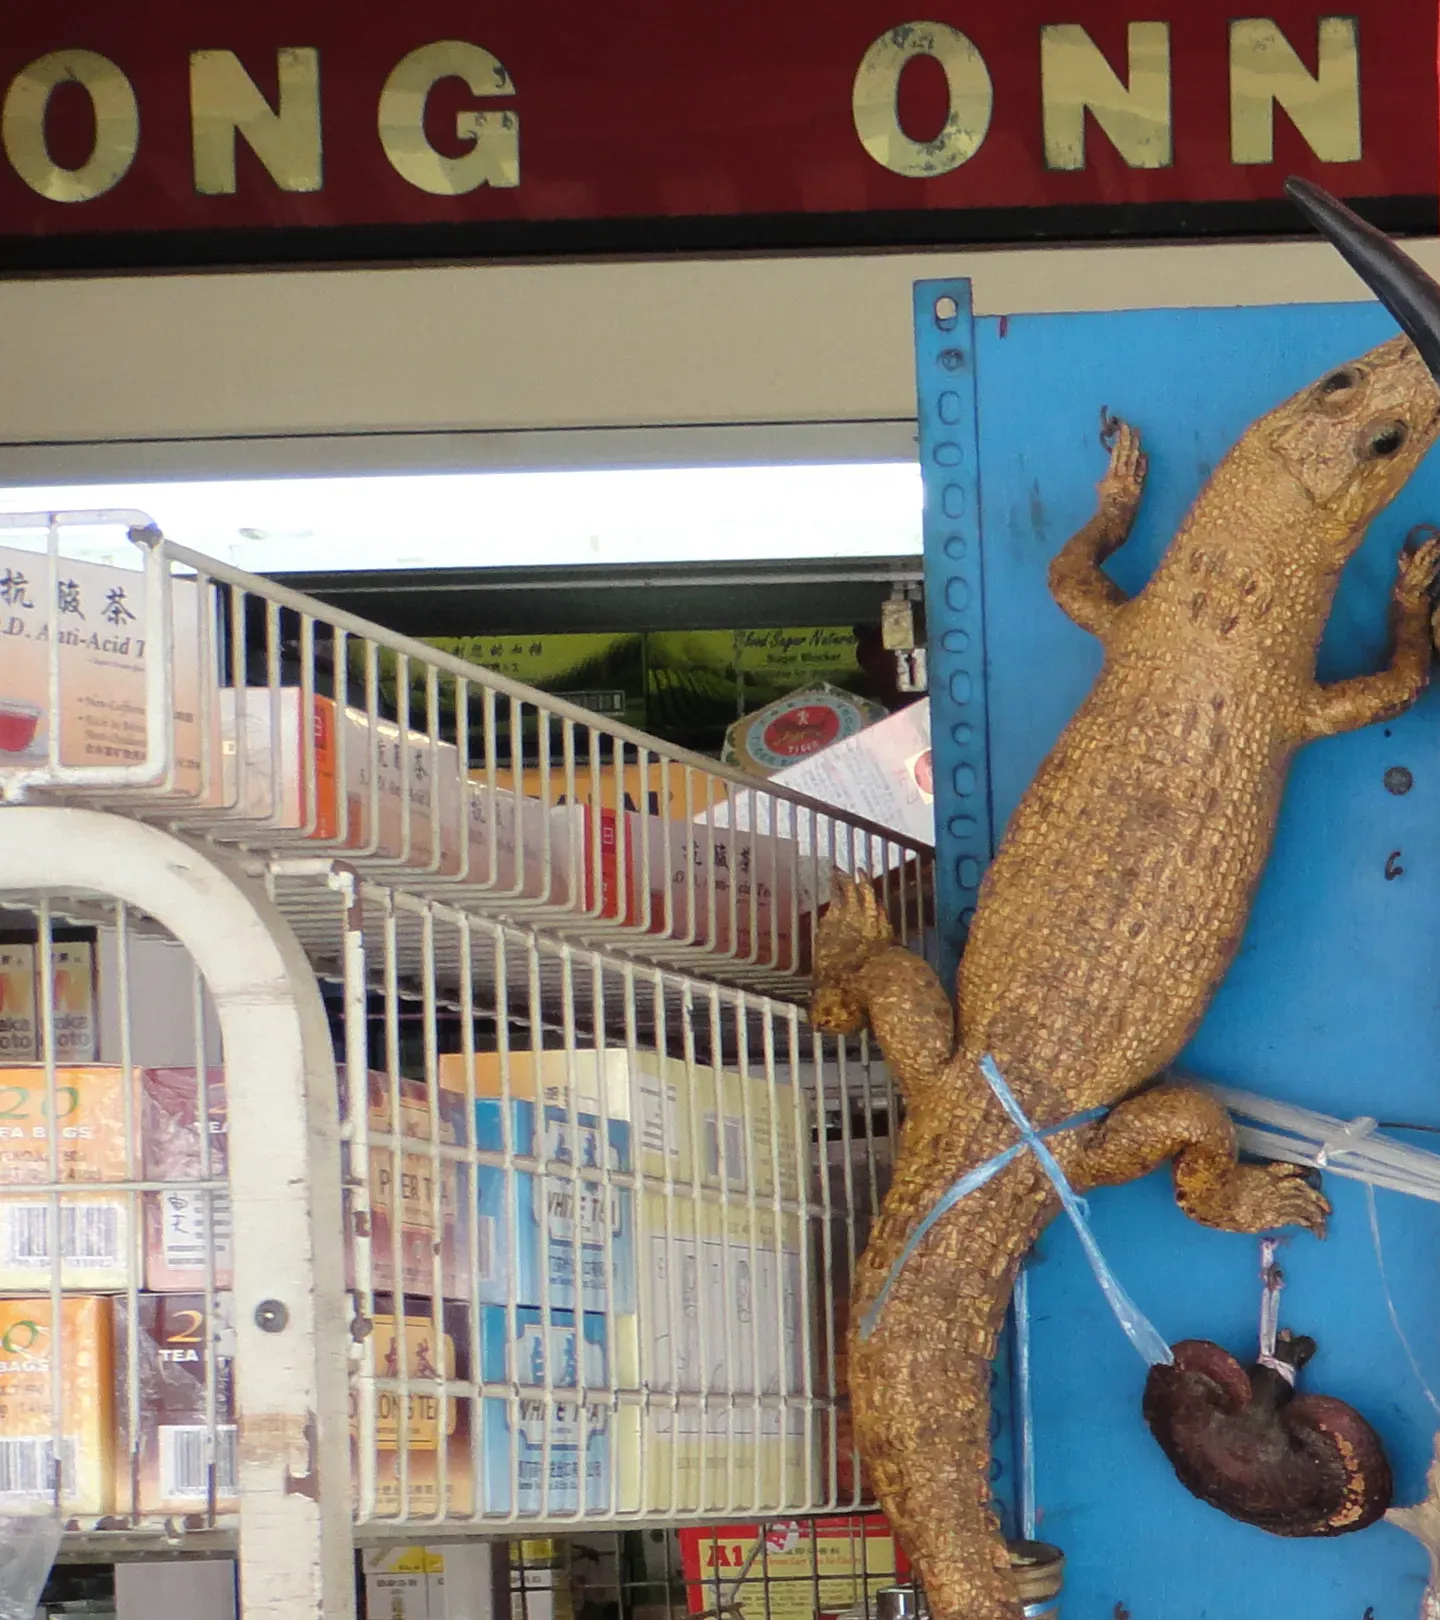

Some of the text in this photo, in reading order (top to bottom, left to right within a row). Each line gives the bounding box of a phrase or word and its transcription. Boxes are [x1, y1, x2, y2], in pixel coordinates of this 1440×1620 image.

[2, 18, 1361, 202] ONG ONN
[0, 1126, 94, 1139] EA BGS
[159, 1349, 199, 1362] TEA
[707, 1545, 744, 1567] A1
